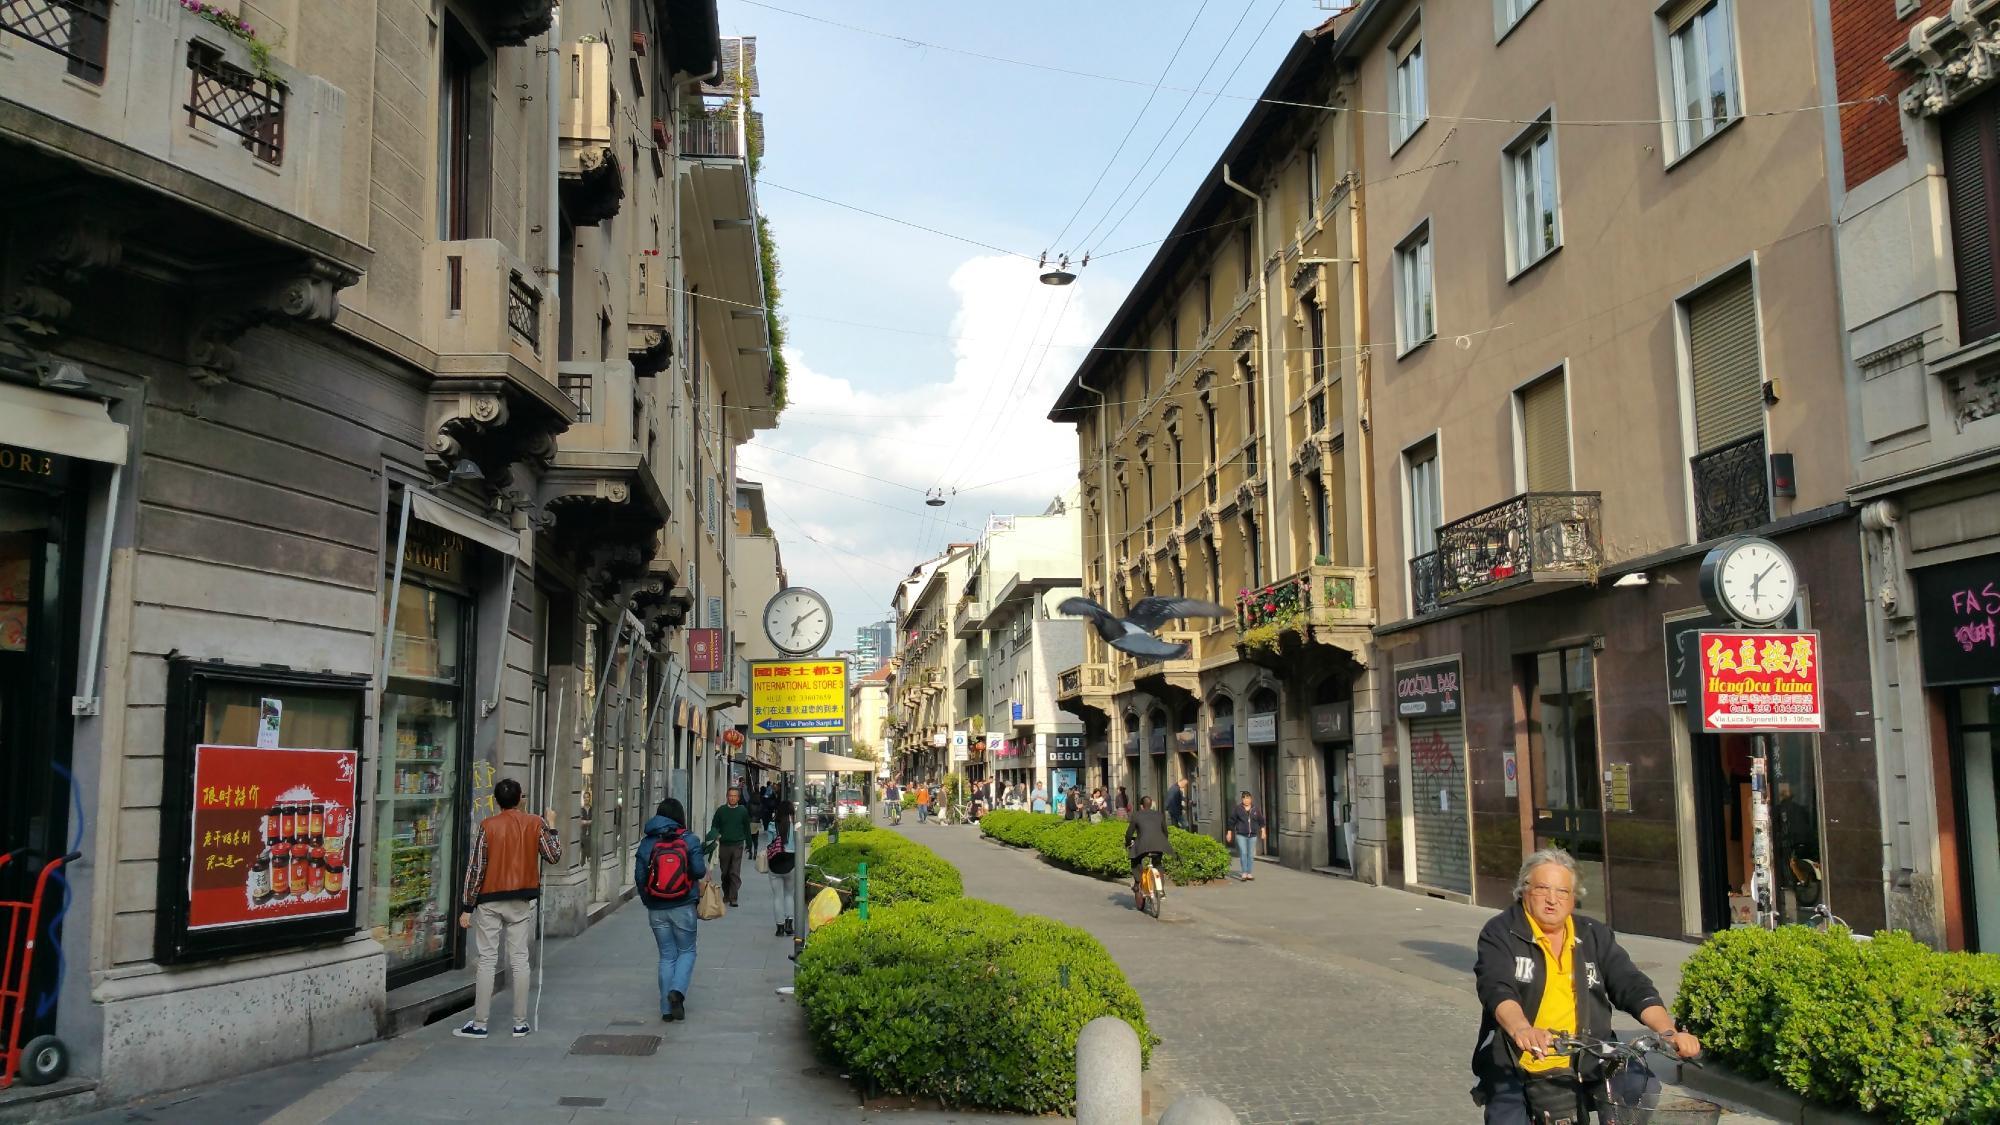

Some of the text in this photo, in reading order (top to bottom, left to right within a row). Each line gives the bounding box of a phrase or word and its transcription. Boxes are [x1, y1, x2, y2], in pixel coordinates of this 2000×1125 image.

[1707, 636, 1813, 678] 红豆按摩
[754, 680, 844, 691] INTERNATIONAL STORE 3
[1438, 672, 1458, 692] BAR
[1709, 677, 1813, 694] HongDou Tuina
[785, 720, 797, 728] Via
[797, 719, 814, 727] Paolo
[815, 718, 832, 728] Sarpi
[1714, 714, 1726, 723] Via
[1727, 714, 1744, 723] Luca
[1056, 738, 1080, 747] LIB
[1049, 752, 1082, 761] DEGLI
